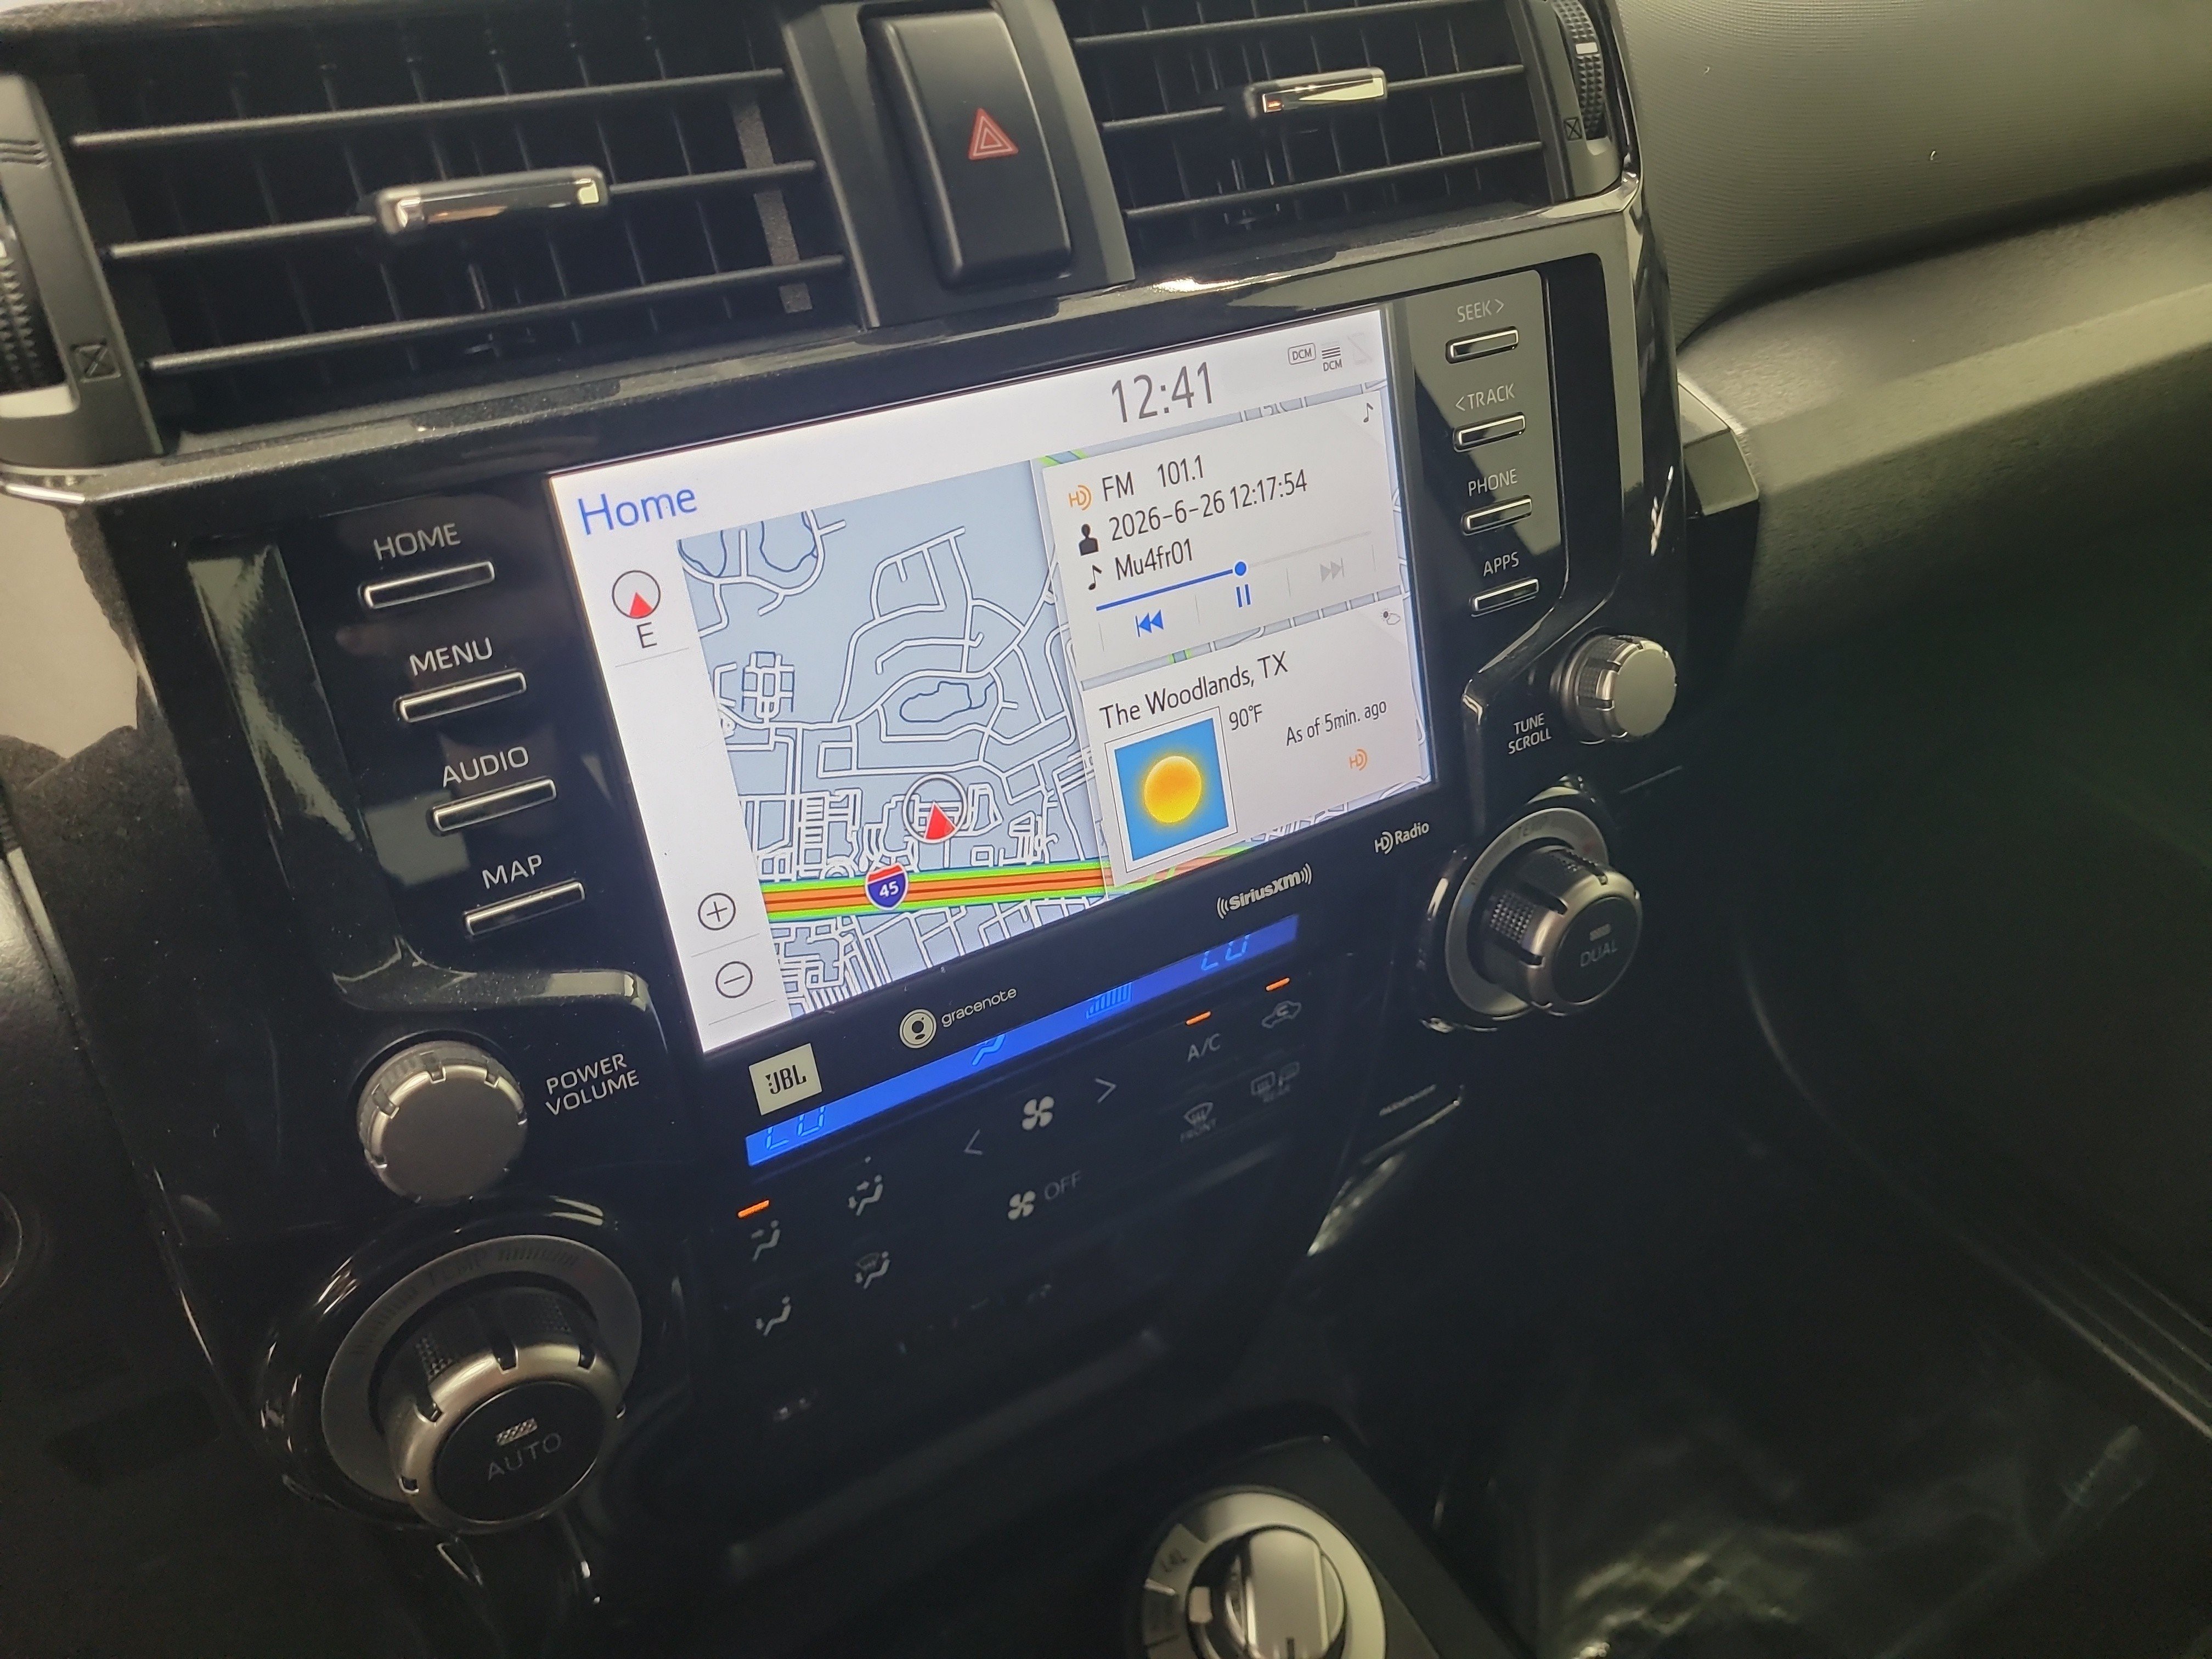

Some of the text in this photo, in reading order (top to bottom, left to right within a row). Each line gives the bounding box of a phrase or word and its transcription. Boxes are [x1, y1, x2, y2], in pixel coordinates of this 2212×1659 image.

[1457, 300, 1492, 323] SEEK
[1293, 348, 1312, 360] DCM
[1323, 359, 1342, 371] DCM
[1111, 362, 1214, 423] 12:41
[1468, 383, 1515, 411] TRACK
[1102, 455, 1205, 502] FM 101.1
[1468, 469, 1517, 496] PHONE
[579, 488, 698, 535] Home
[1109, 469, 1307, 541] 2026-6-26 12:17:54
[373, 523, 460, 561] HOME
[1115, 538, 1193, 580] Mu4fr01
[1482, 552, 1520, 577] APPS
[637, 622, 657, 648] E
[409, 637, 493, 675] MENU
[1100, 651, 1288, 730] The Woodlands, TX
[1229, 703, 1263, 731] 90°F
[1286, 701, 1386, 746] As of 5min. ago
[1514, 713, 1545, 736] TUNE
[1507, 727, 1551, 755] SCROLL
[442, 747, 529, 787] AUDIO
[1395, 821, 1430, 845] Radio
[482, 854, 542, 889] MAP
[879, 881, 900, 897] 45
[941, 988, 1018, 1029] gracenote
[1188, 1033, 1221, 1062] A/C
[546, 1053, 627, 1094] POWER
[765, 1064, 806, 1095] JBL
[545, 1070, 640, 1116] VOLUME
[1044, 1169, 1081, 1200] OFF
[488, 1432, 562, 1481] AUTO
